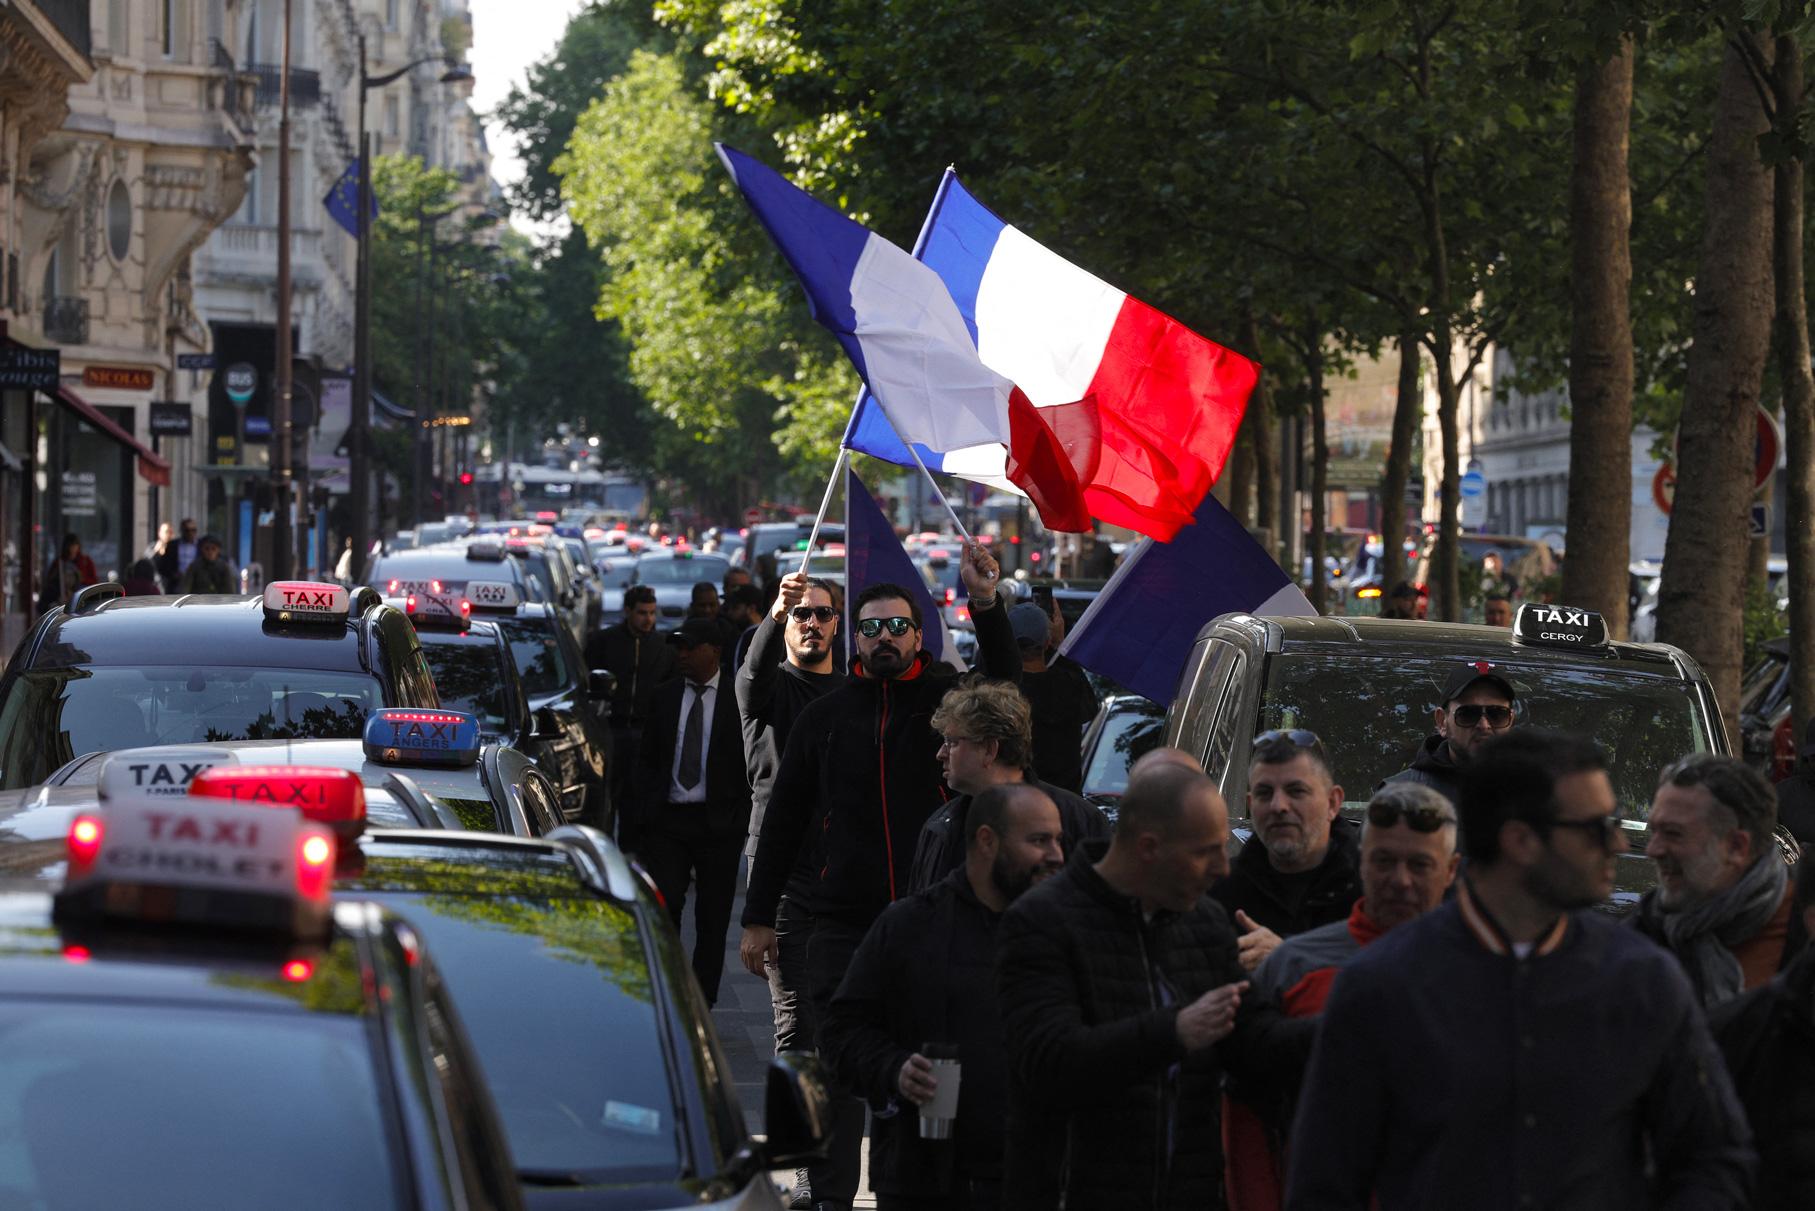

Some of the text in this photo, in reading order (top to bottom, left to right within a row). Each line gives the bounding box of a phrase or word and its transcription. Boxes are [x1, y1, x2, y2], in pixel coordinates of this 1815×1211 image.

[89, 370, 149, 387] NICOLAS
[228, 371, 253, 386] BUS
[401, 581, 428, 590] TAXI
[474, 585, 506, 595] TAXI
[283, 591, 333, 607] TAXI
[425, 596, 453, 606] TAXI
[282, 603, 331, 612] CHERRE
[1532, 609, 1589, 627] TAXI
[1540, 632, 1584, 642] CERGY
[389, 721, 458, 741] TAXI
[391, 738, 450, 750] ANGERS
[387, 750, 396, 760] A
[129, 763, 213, 786] TAX
[224, 784, 326, 805] TAXI
[143, 813, 260, 847] TAXI
